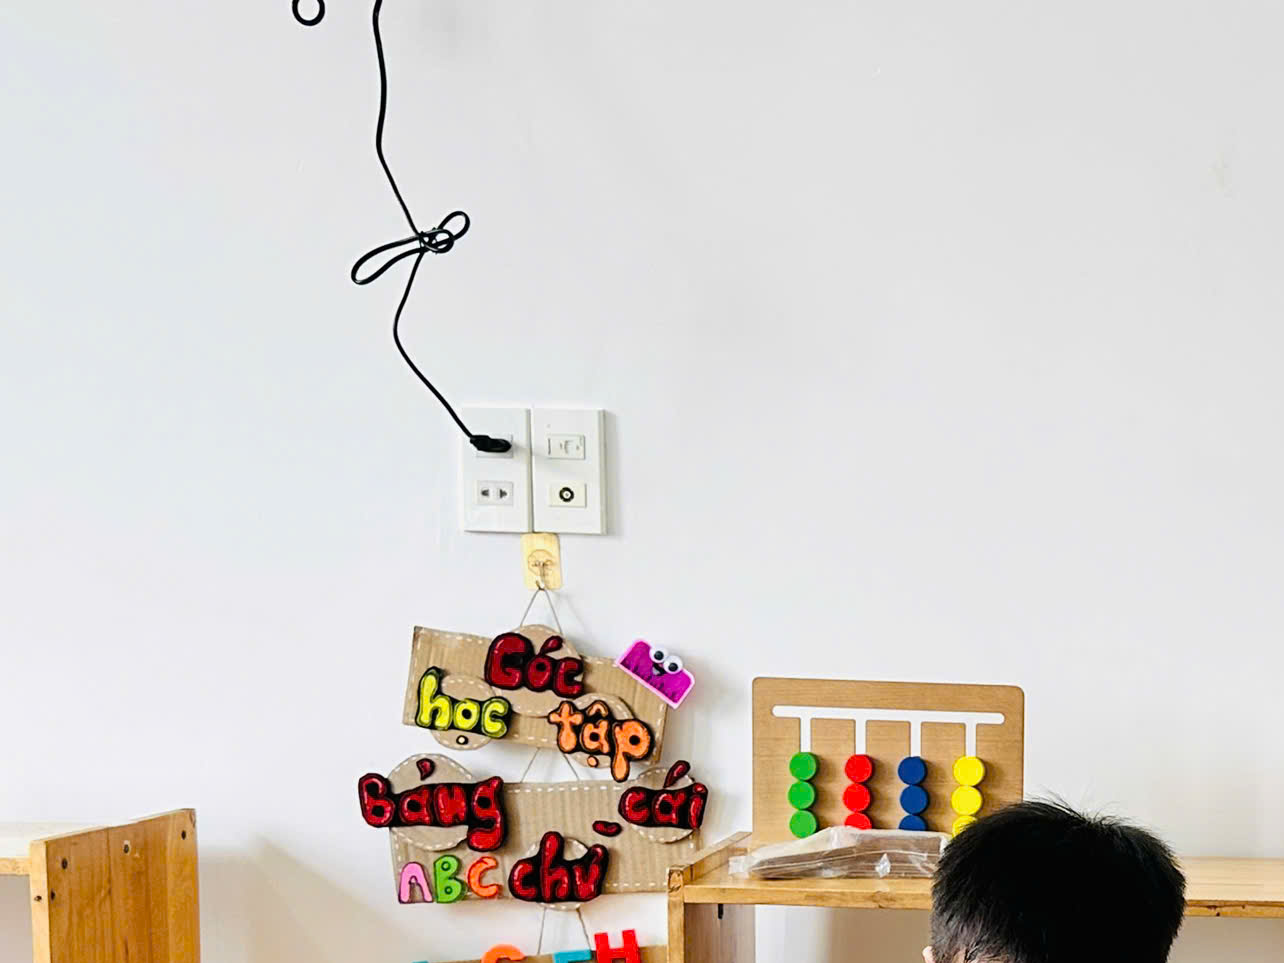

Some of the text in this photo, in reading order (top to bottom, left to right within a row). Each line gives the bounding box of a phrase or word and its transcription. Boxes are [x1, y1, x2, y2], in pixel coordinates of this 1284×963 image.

[415, 665, 654, 783] học tập
[617, 760, 709, 829] cái
